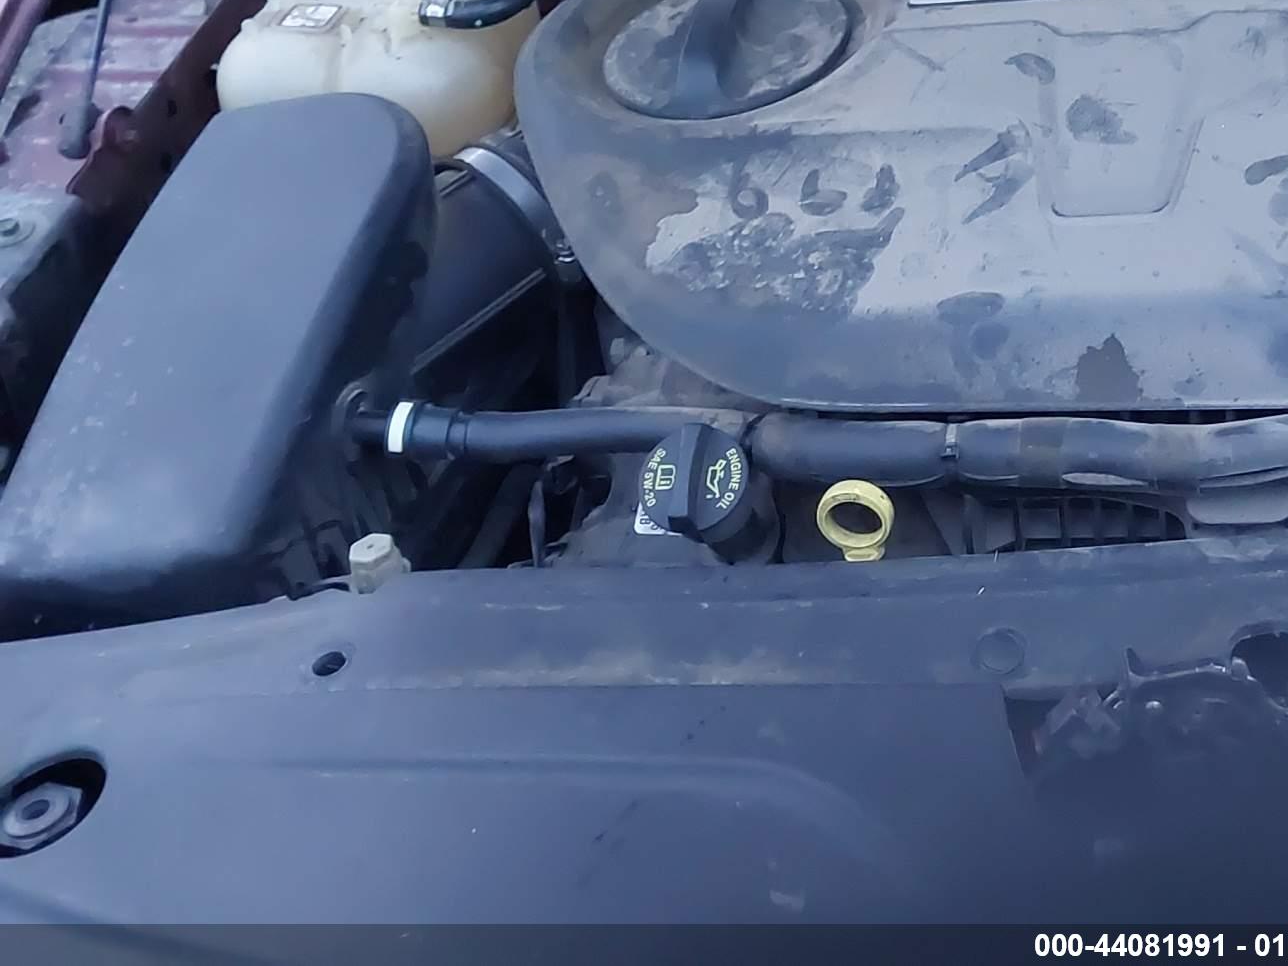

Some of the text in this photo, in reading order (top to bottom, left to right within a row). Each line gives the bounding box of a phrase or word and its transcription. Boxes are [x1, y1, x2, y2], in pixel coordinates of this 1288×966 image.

[647, 447, 667, 471] SAE
[715, 447, 742, 510] ENGINE OIL
